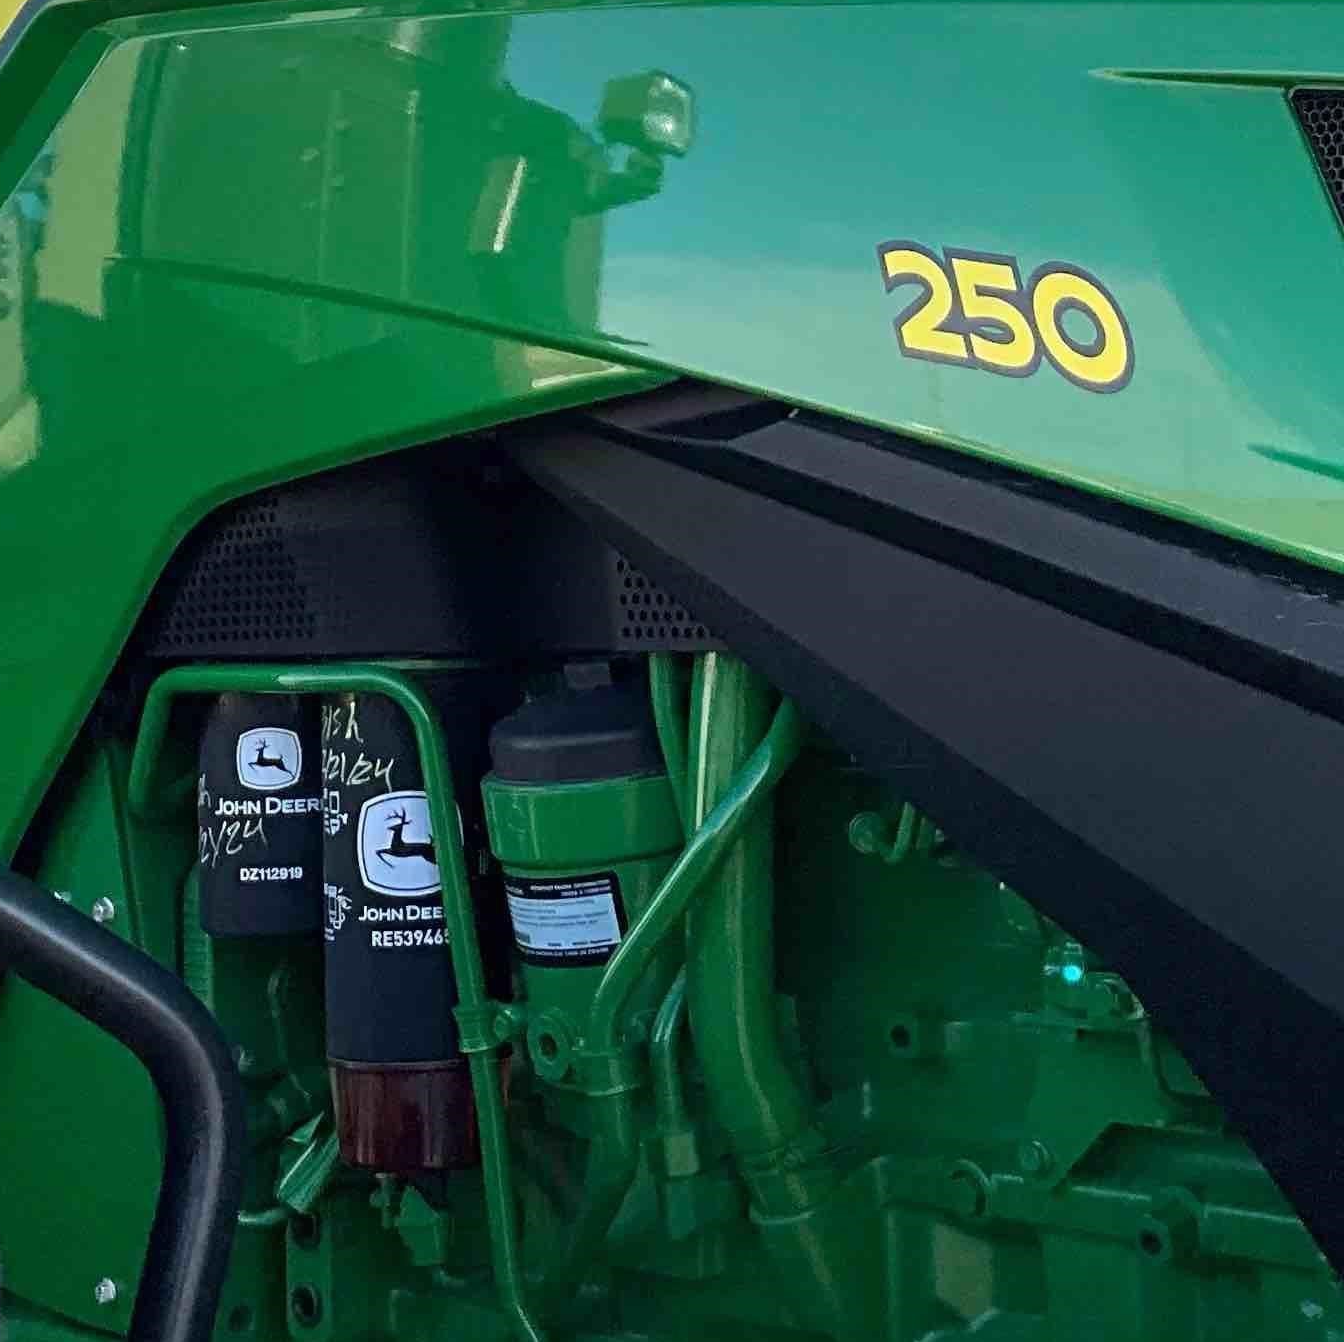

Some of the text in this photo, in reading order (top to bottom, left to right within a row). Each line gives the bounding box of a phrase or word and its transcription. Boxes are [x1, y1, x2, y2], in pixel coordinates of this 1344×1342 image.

[876, 239, 1136, 395] 250
[214, 796, 322, 815] JOHN DEER
[358, 904, 446, 921] JOHN DEE
